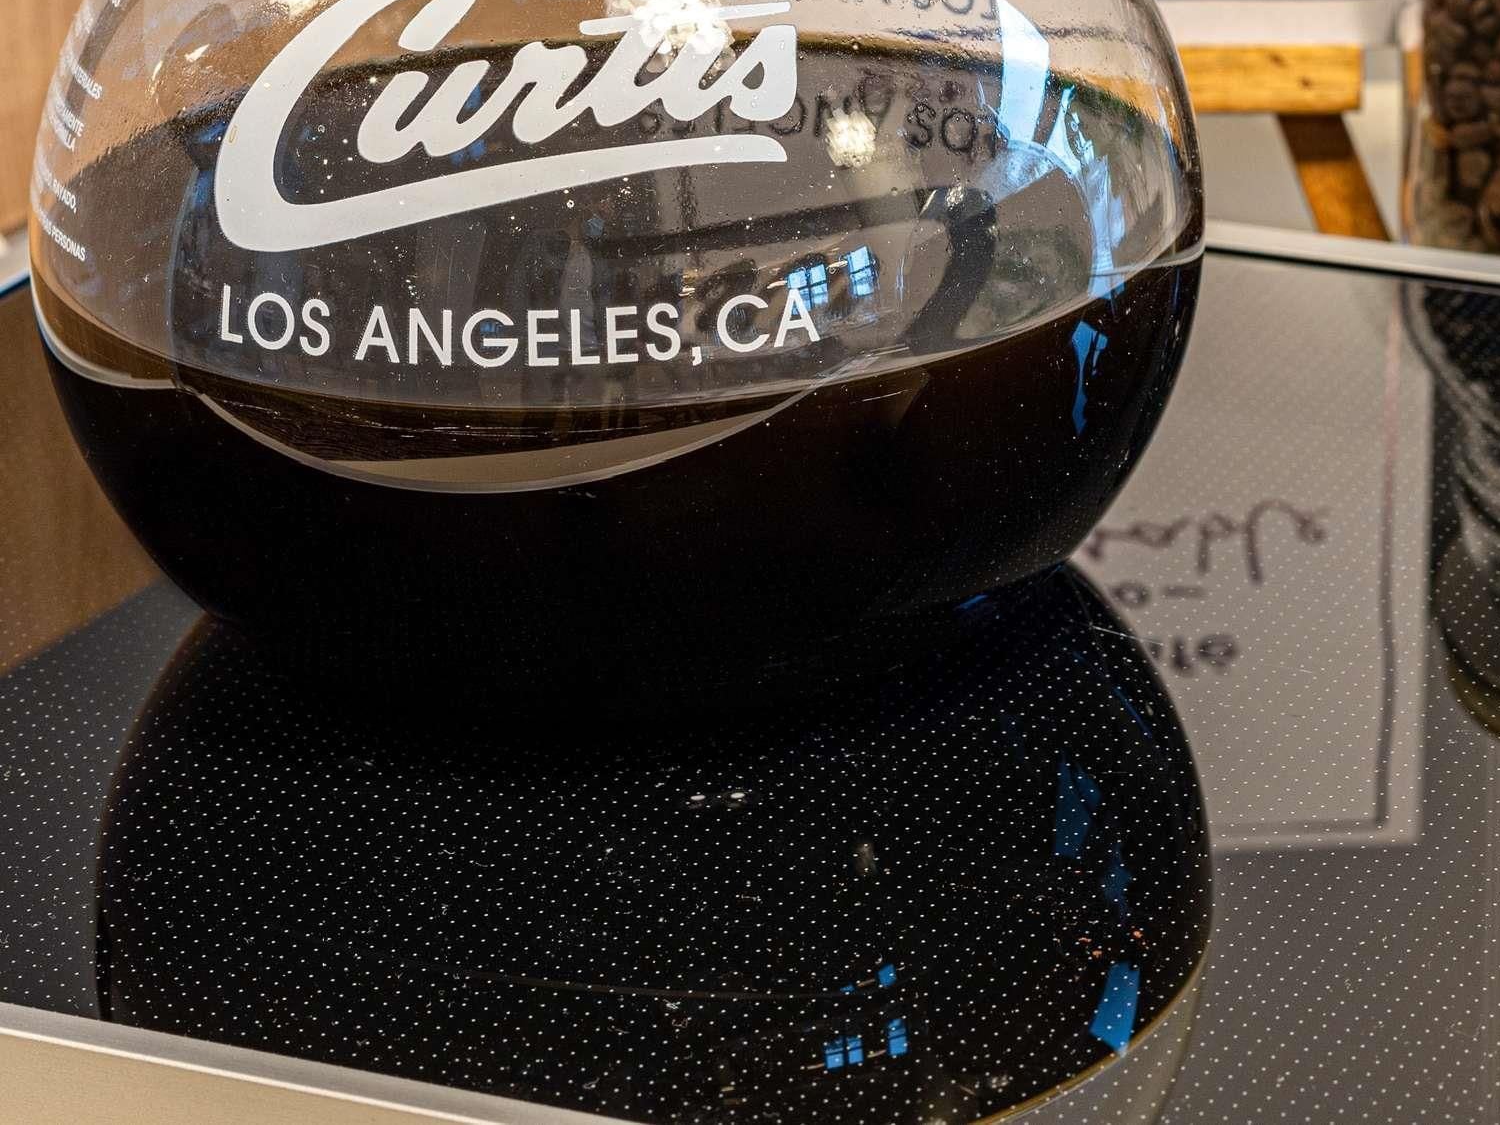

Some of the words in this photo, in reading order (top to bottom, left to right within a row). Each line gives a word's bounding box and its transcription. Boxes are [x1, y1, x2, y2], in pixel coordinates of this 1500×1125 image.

[219, 283, 332, 359] LOS
[355, 304, 703, 368] ANGELES,
[715, 291, 822, 354] CA
